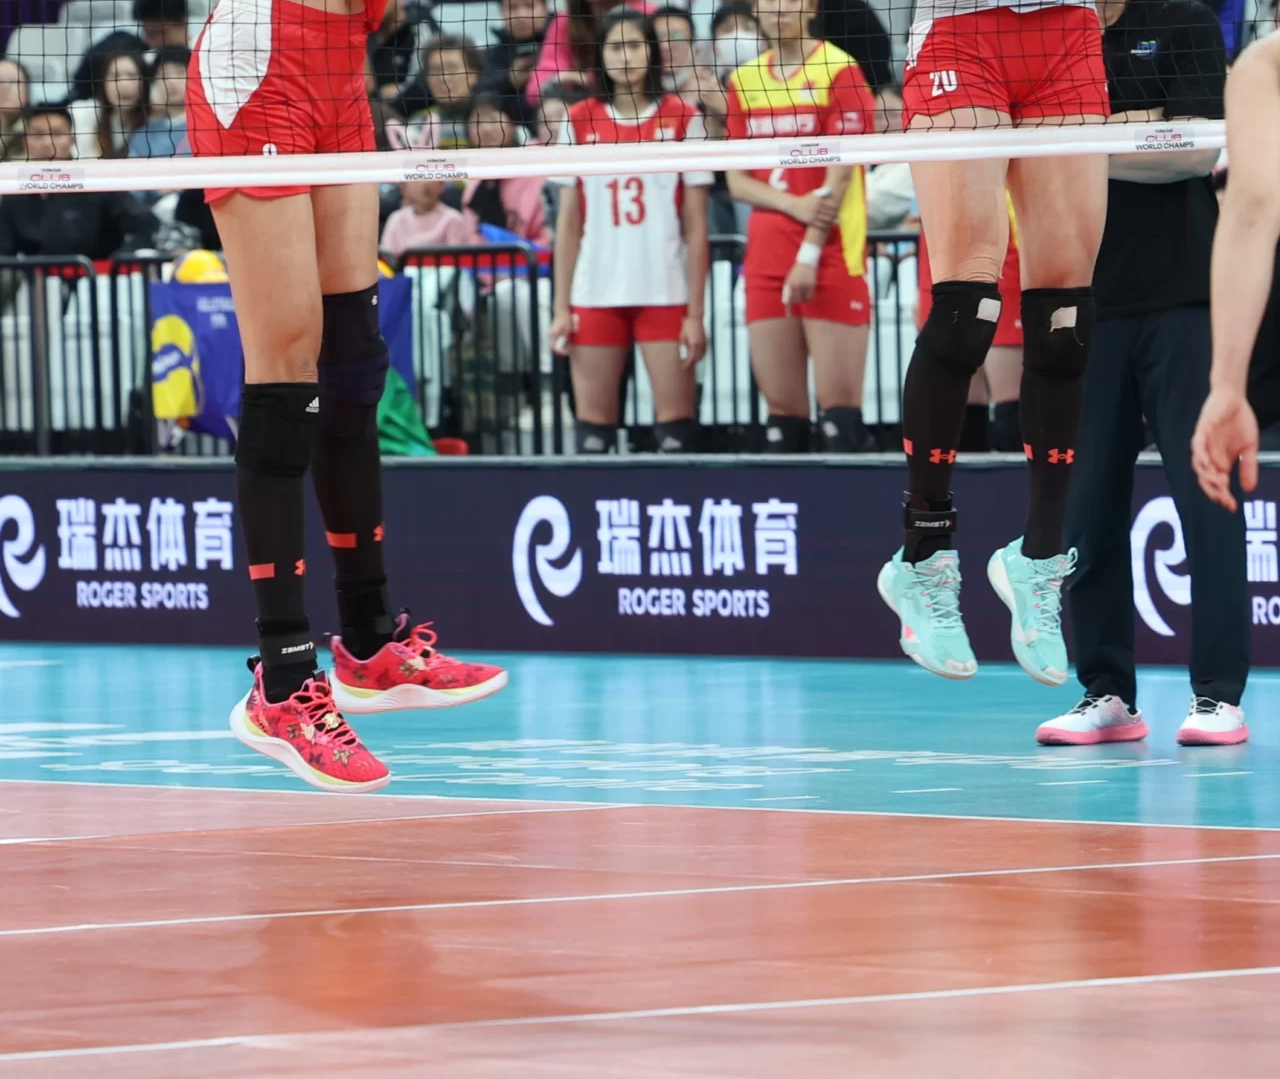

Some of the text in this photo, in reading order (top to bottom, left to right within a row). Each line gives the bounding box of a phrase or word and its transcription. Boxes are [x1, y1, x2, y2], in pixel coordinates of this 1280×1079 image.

[1145, 133, 1182, 142] CLUB
[1136, 141, 1195, 151] WORLD CHAMPS
[789, 148, 829, 157] CLUB
[780, 155, 842, 166] WORLD CHAMPS
[415, 163, 455, 171] CLUB
[29, 173, 71, 181] CLUB
[404, 172, 469, 181] WORLD CHAMPS
[18, 182, 84, 191] WORLD CHAMPS
[606, 176, 646, 227] 13
[55, 497, 234, 571] 瑞杰体育
[595, 498, 799, 577] 瑞杰体育
[76, 581, 209, 610] ROGER SPORTS
[618, 587, 771, 618] ROGER SPORTS
